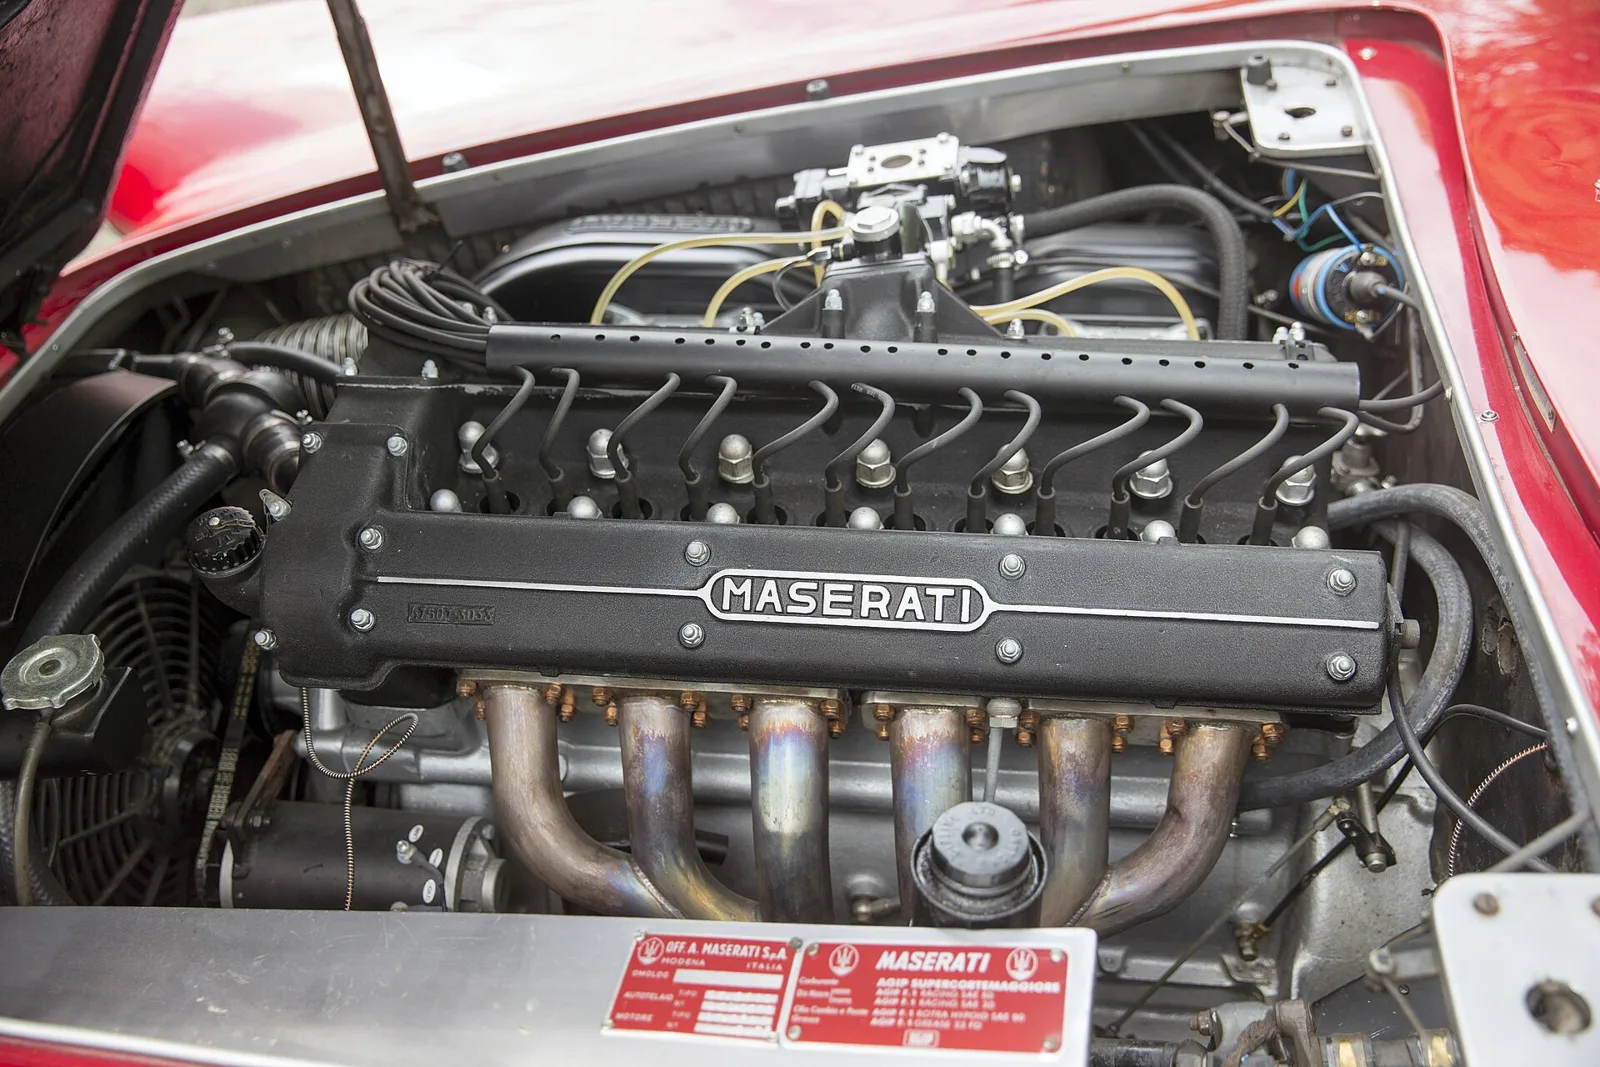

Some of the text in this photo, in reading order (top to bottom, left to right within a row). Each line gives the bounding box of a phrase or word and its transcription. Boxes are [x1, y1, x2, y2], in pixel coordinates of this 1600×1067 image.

[721, 577, 971, 623] MASERATI
[701, 942, 760, 958] MASERATI
[660, 956, 706, 967] MODENA
[746, 961, 783, 972] ITALIA
[875, 950, 992, 973] MASERATI
[876, 977, 1062, 994] AGIP SUPERCORTEMAGGIORE
[623, 990, 674, 1002] AUTOTELAIO
[615, 1012, 654, 1023] MOTORE
